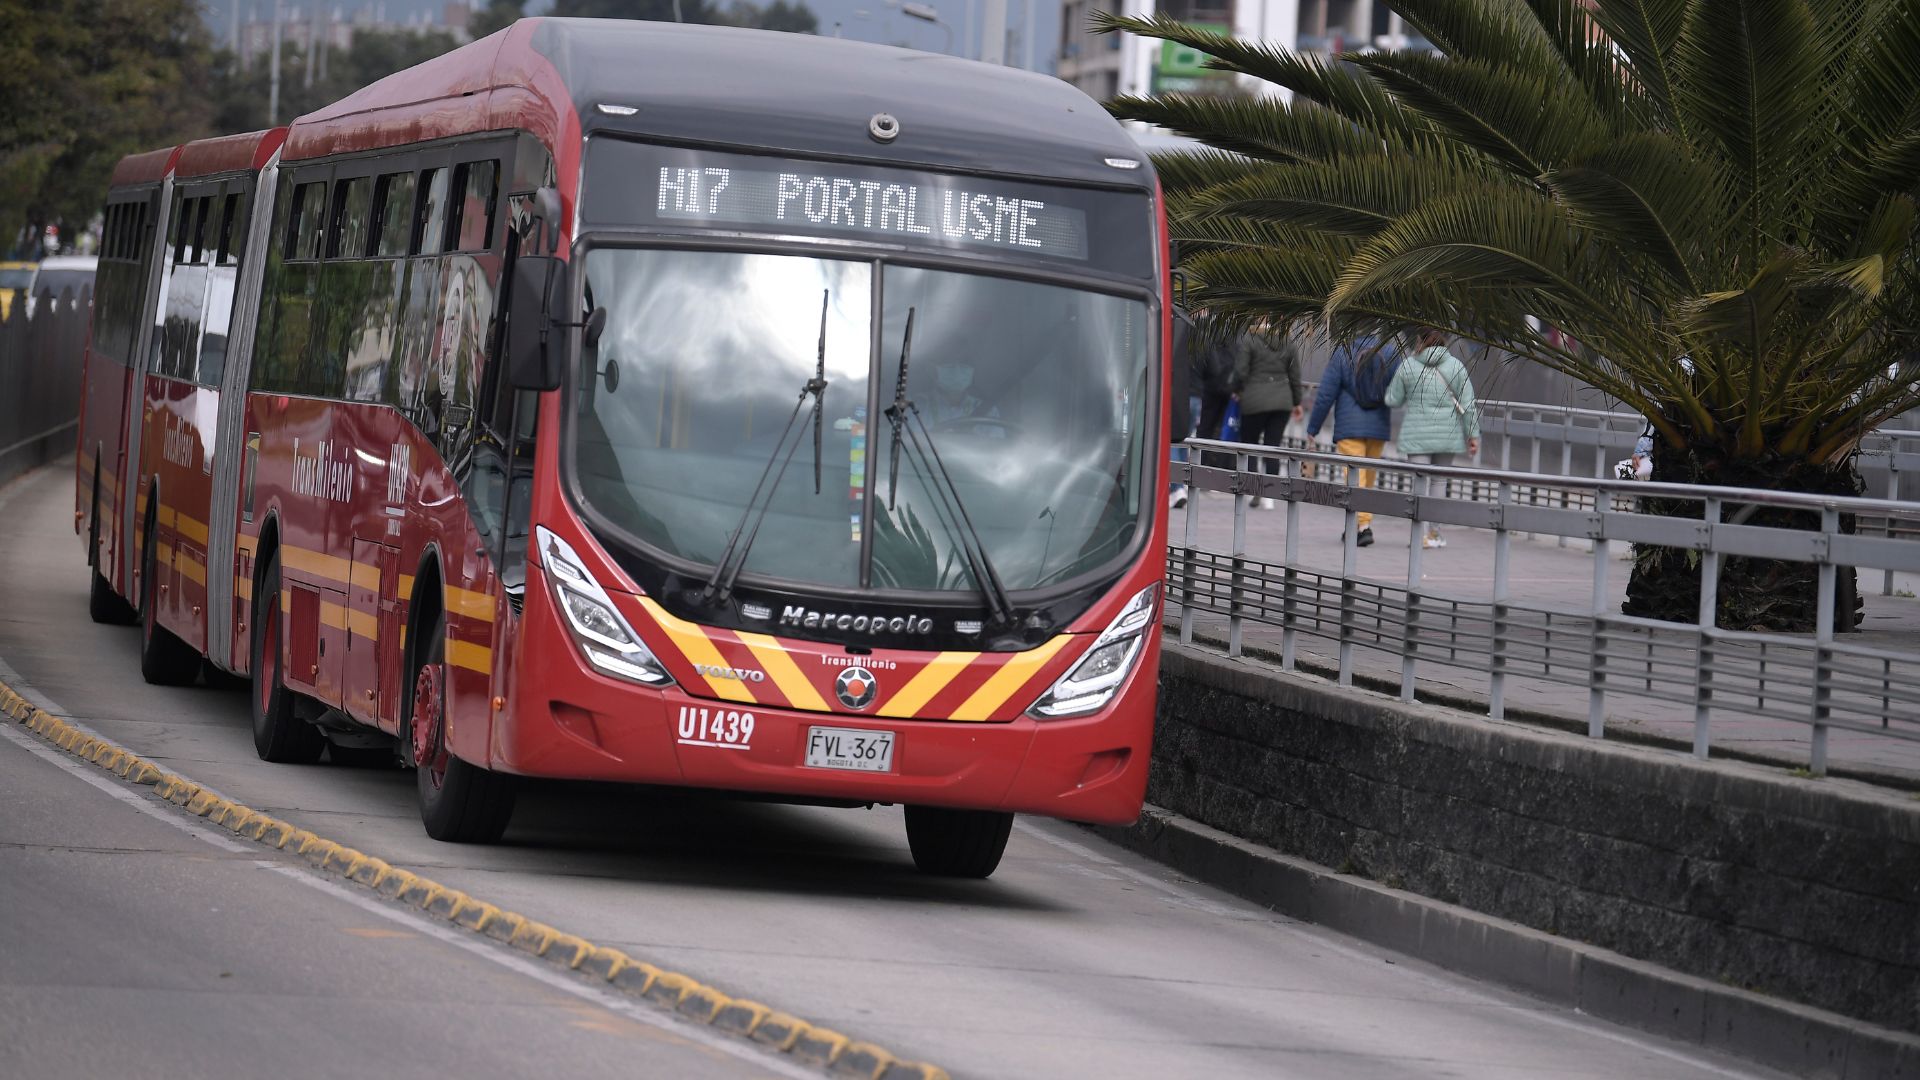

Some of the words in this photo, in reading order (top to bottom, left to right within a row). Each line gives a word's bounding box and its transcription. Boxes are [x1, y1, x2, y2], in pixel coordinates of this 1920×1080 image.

[657, 166, 730, 216] H17
[776, 173, 930, 235] PORTAL
[942, 190, 1045, 248] USME
[291, 437, 353, 503] TransMilenio
[779, 605, 934, 635] Marcopolo
[694, 664, 765, 683] VOLVO
[821, 654, 897, 670] TransMilenio
[677, 707, 755, 745] U1439
[853, 738, 890, 760] 367
